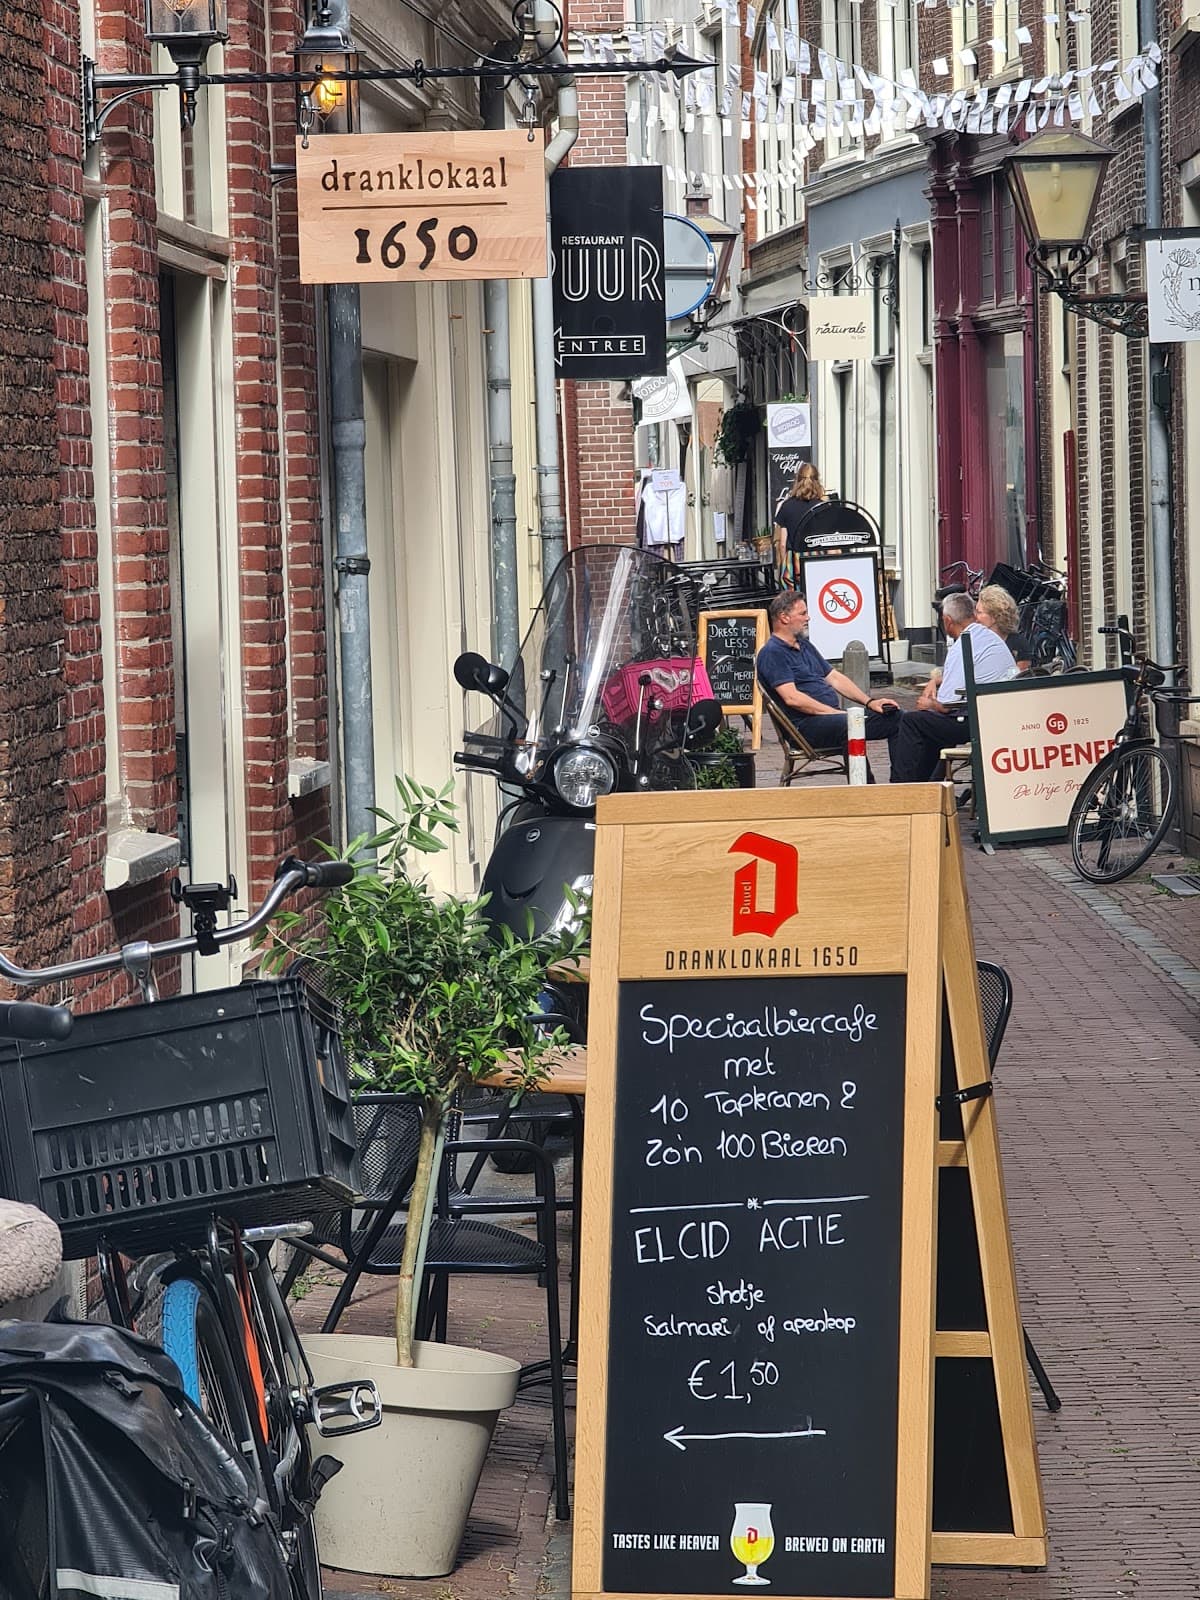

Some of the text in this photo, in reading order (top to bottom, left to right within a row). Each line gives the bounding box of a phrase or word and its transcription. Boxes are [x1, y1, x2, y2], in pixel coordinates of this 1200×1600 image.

[321, 157, 508, 192] dranklokaal
[354, 218, 479, 270] 1650
[561, 235, 625, 246] RESTAURANT
[551, 236, 663, 302] UUR
[815, 321, 867, 335] naturals
[557, 340, 641, 353] ENTREE
[724, 637, 749, 649] LESS
[1021, 717, 1090, 732] ANNO GB 1825
[1013, 779, 1084, 801] De Vrije Bro
[665, 946, 859, 971] DRANKLOKAAL 1650
[640, 1003, 880, 1054] Speciaalbiercafe
[724, 1047, 776, 1080] met
[650, 1094, 689, 1125] 10
[704, 1085, 830, 1118] Tapkranen
[717, 1130, 756, 1160] 100
[759, 1213, 846, 1252] ACTIE
[757, 1315, 776, 1342] of
[612, 1533, 720, 1551] TASTES LIKE HEAVEN
[784, 1536, 886, 1554] BREWED ON EARTH
